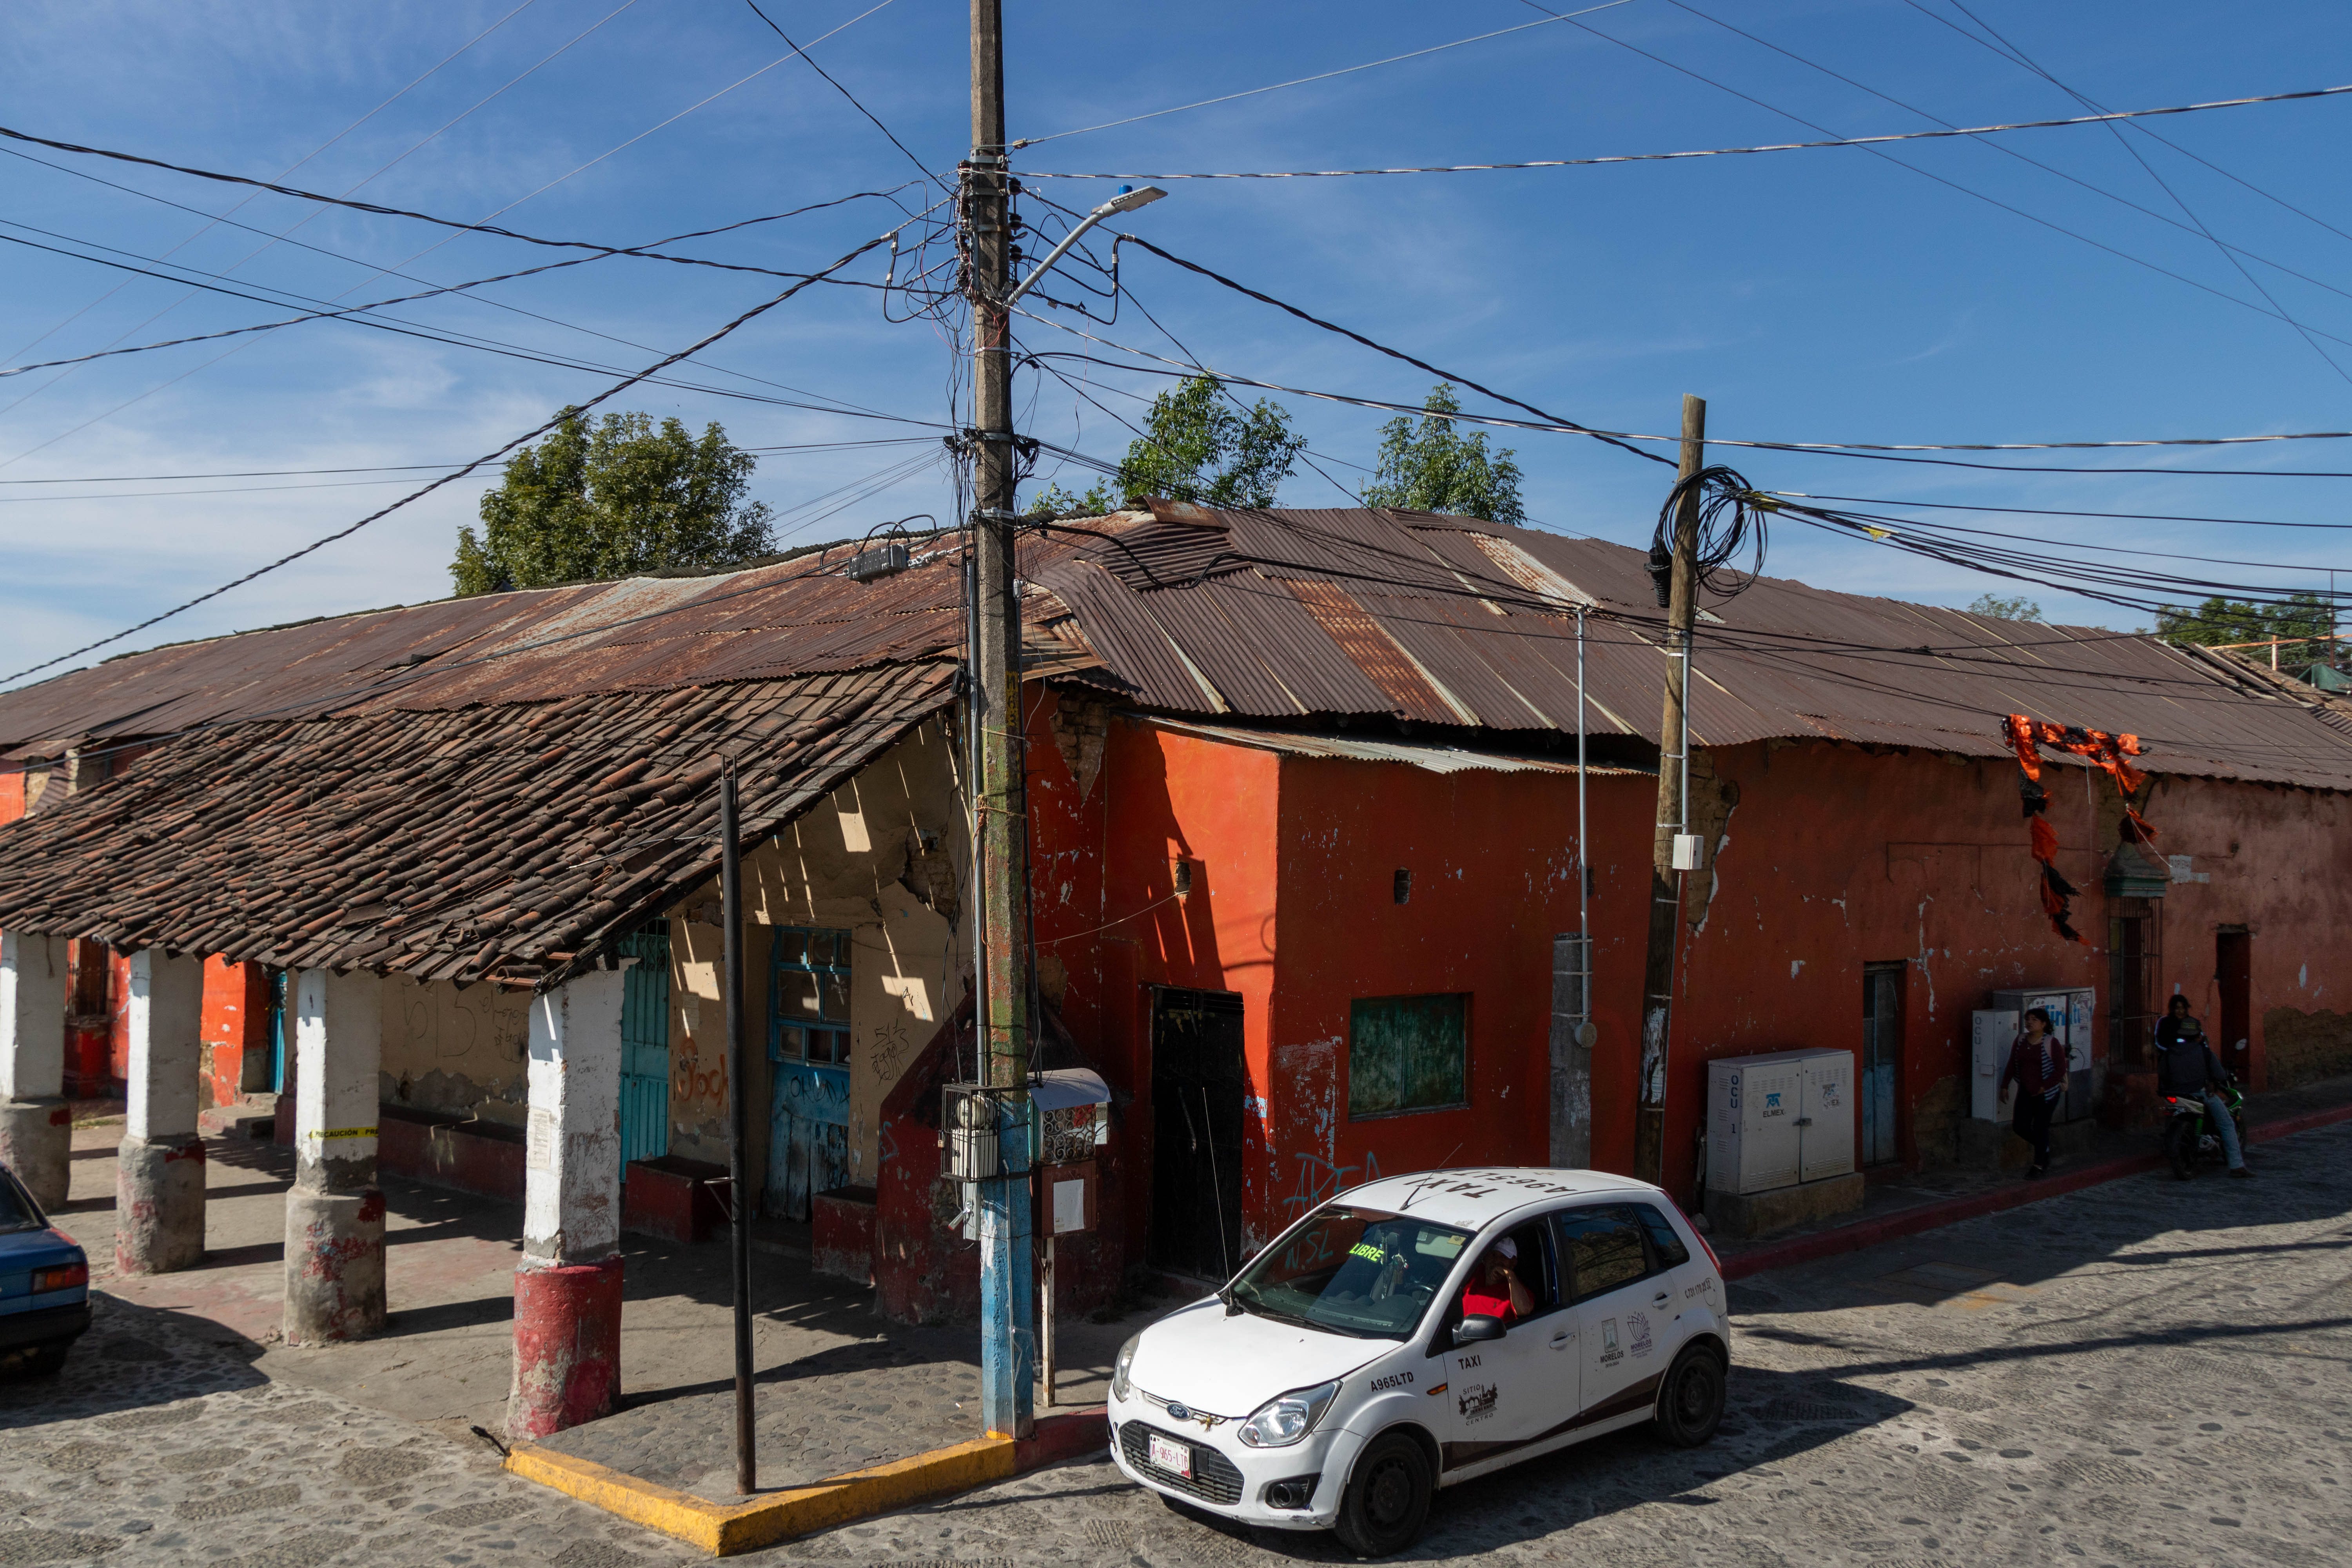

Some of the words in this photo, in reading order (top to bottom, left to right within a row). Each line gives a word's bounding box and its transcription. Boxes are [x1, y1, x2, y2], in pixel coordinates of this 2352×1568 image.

[1730, 1075, 1739, 1109] OCU
[1731, 1124, 1736, 1134] 1
[1402, 1178, 1499, 1198] TAXI
[1348, 1243, 1385, 1262] LIBRE
[1631, 1338, 1652, 1350] MORELOS
[1458, 1355, 1481, 1370] TAXI
[1600, 1350, 1624, 1363] MORELOS
[1371, 1372, 1414, 1392] A965LTD
[1463, 1384, 1480, 1395] SITIO
[1170, 1406, 1184, 1417] Ford
[1466, 1413, 1494, 1426] CENTRO
